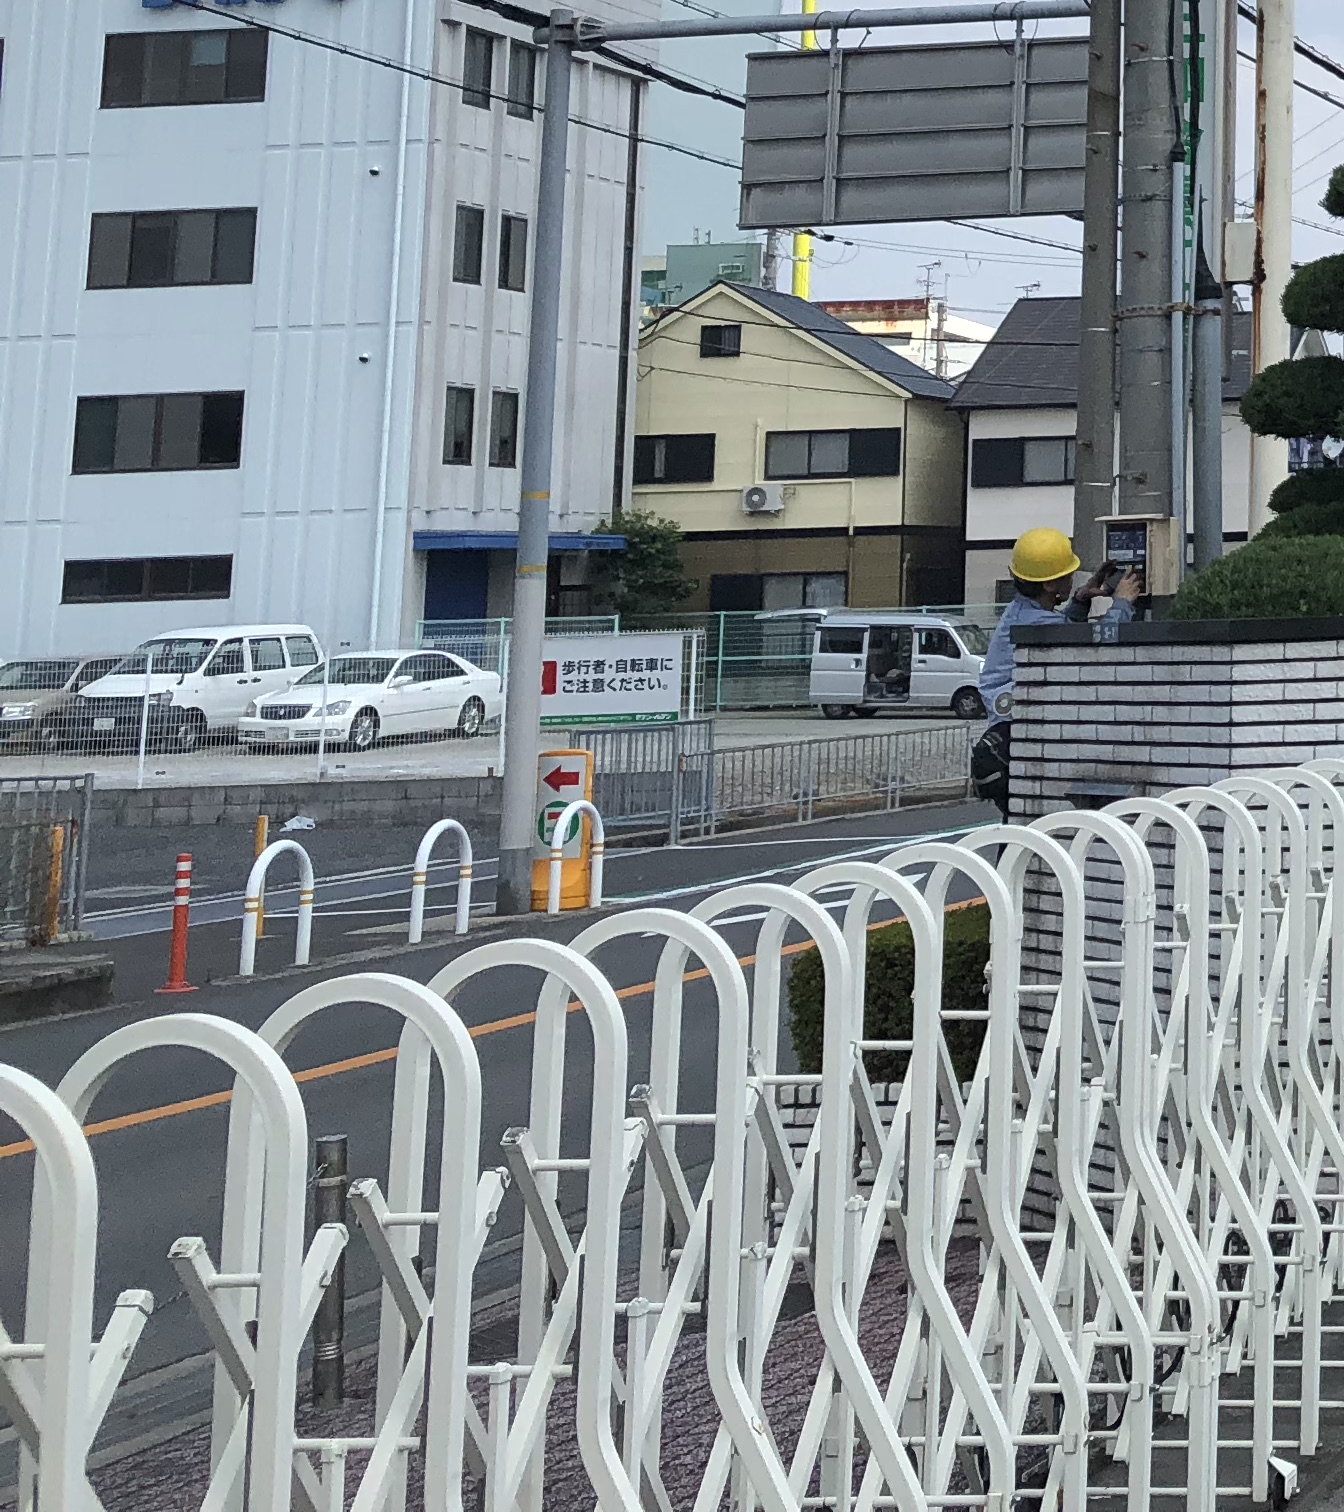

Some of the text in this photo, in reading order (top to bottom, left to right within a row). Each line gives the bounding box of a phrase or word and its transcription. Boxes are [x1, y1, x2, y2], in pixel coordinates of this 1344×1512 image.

[561, 657, 674, 676] 歩行者・自転車に
[562, 676, 669, 694] ご注意ください。
